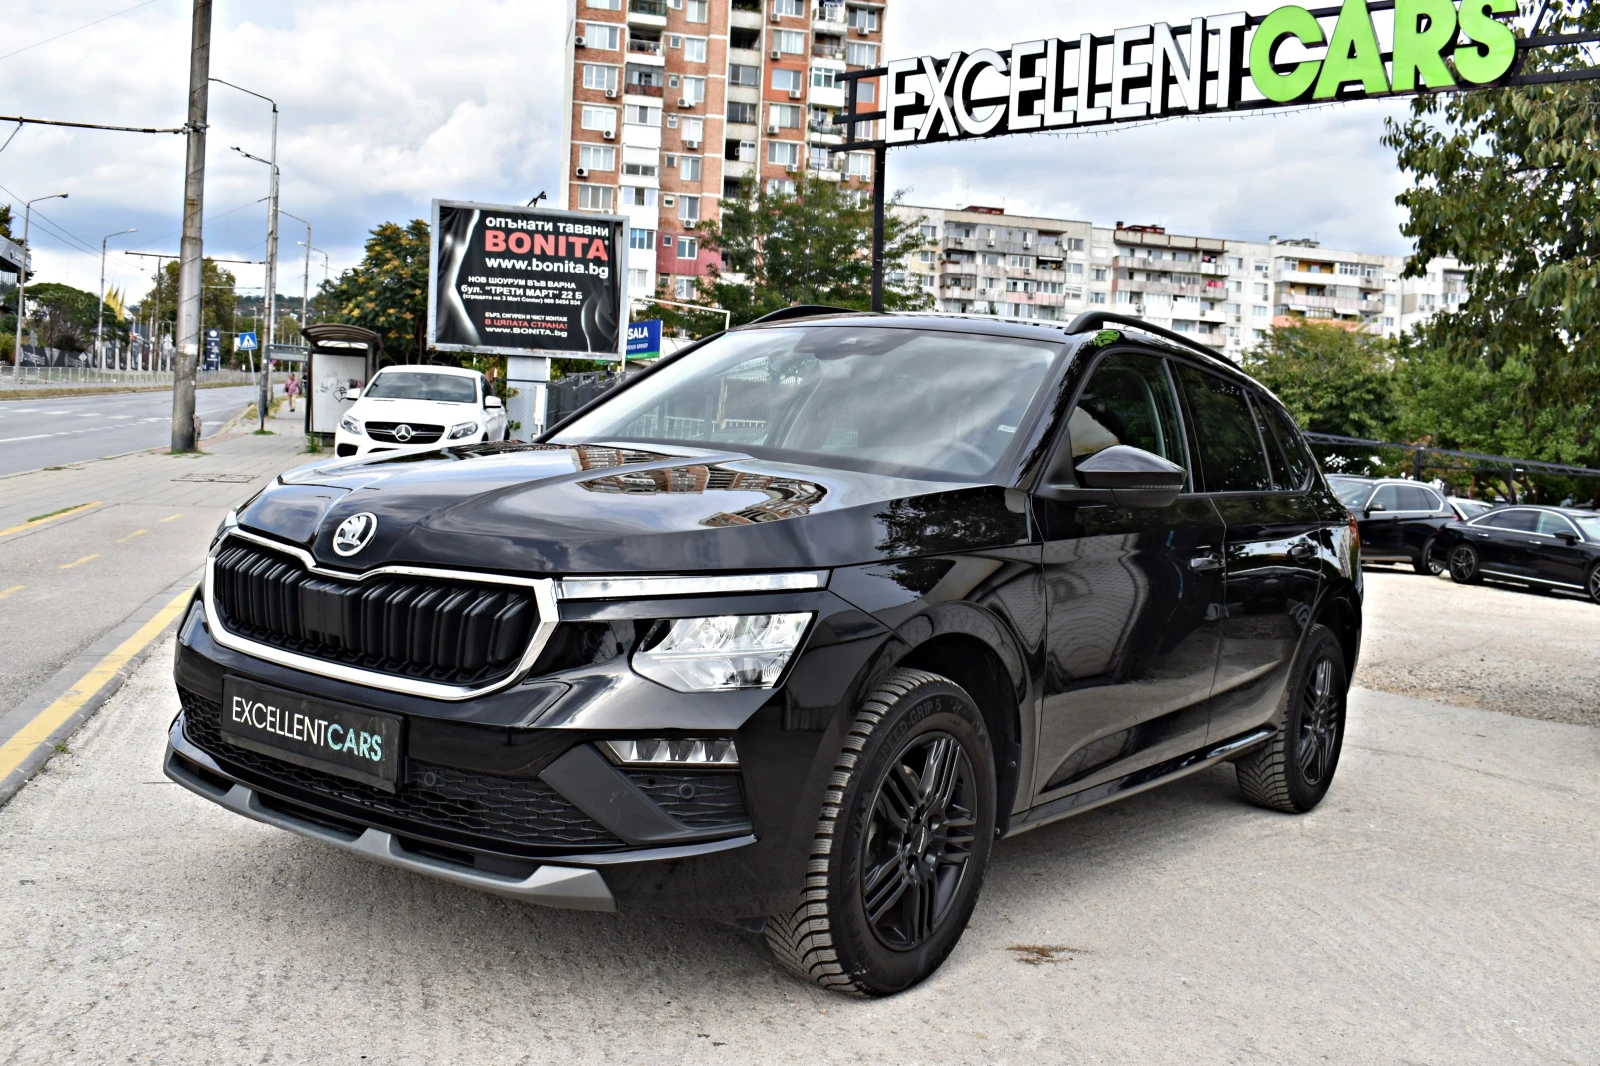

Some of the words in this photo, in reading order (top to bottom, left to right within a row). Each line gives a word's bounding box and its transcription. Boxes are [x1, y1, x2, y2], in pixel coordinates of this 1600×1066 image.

[485, 217, 553, 232] опънати
[557, 222, 609, 237] тавани
[485, 257, 609, 279] www.bonita.bg
[489, 277, 526, 286] ШОУРУМ
[547, 281, 576, 289] ВАРНА
[461, 284, 483, 294] бул.
[561, 291, 573, 299] 22
[494, 319, 529, 328] ЦЯЛАТА
[530, 321, 568, 330] СТРАНА!
[485, 326, 568, 338] www.BONITA.bg
